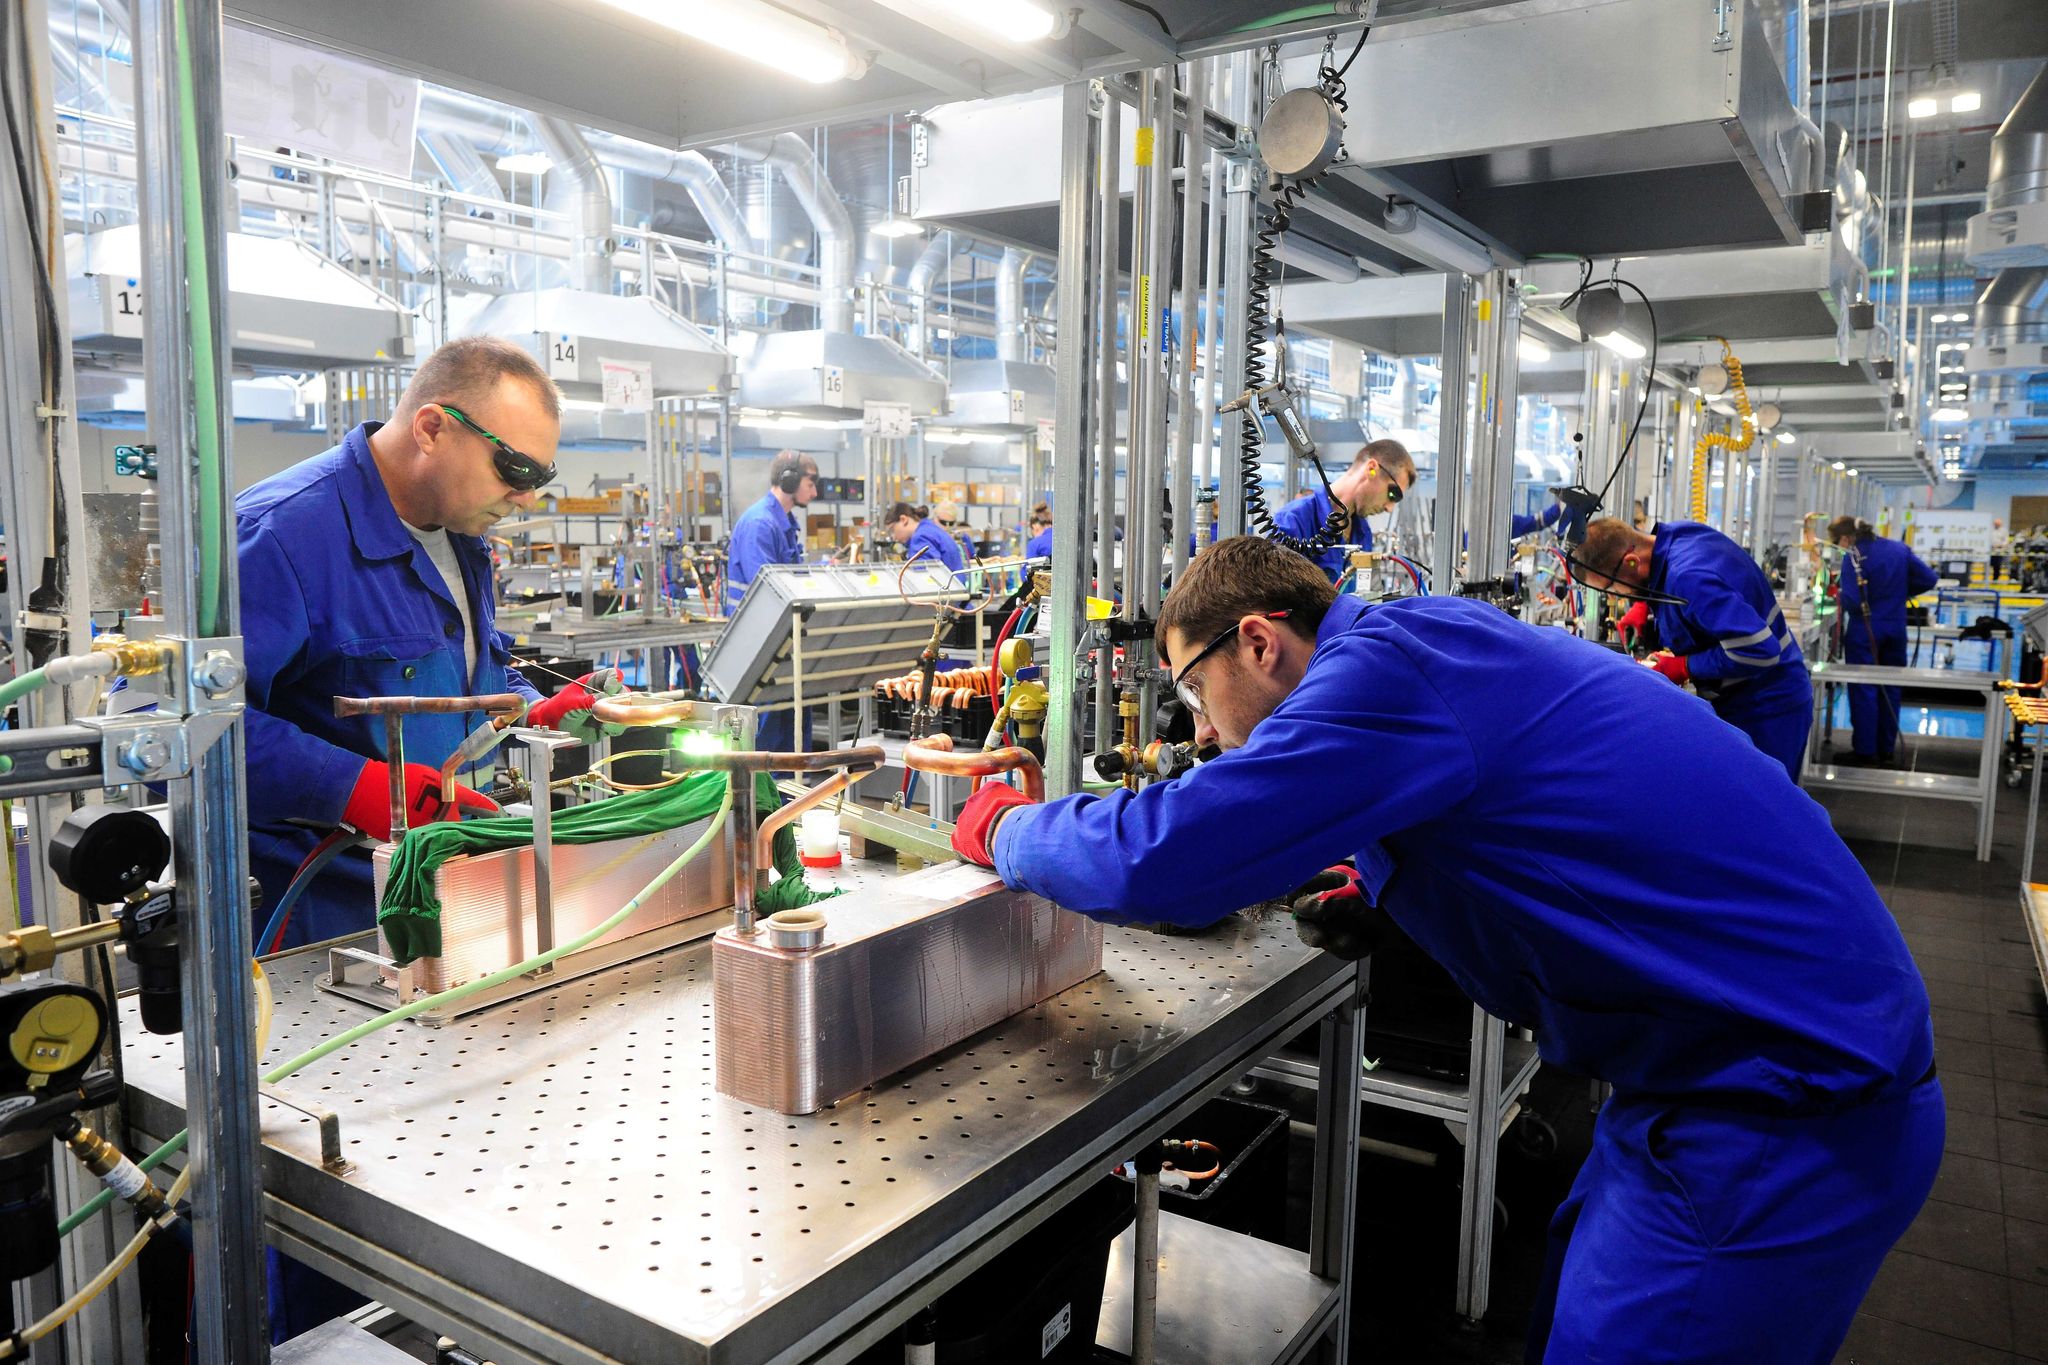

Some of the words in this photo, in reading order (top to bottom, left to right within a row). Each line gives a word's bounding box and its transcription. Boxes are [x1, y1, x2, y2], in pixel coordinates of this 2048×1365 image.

[554, 343, 576, 362] 14
[826, 376, 842, 392] 16
[1013, 399, 1024, 412] 18
